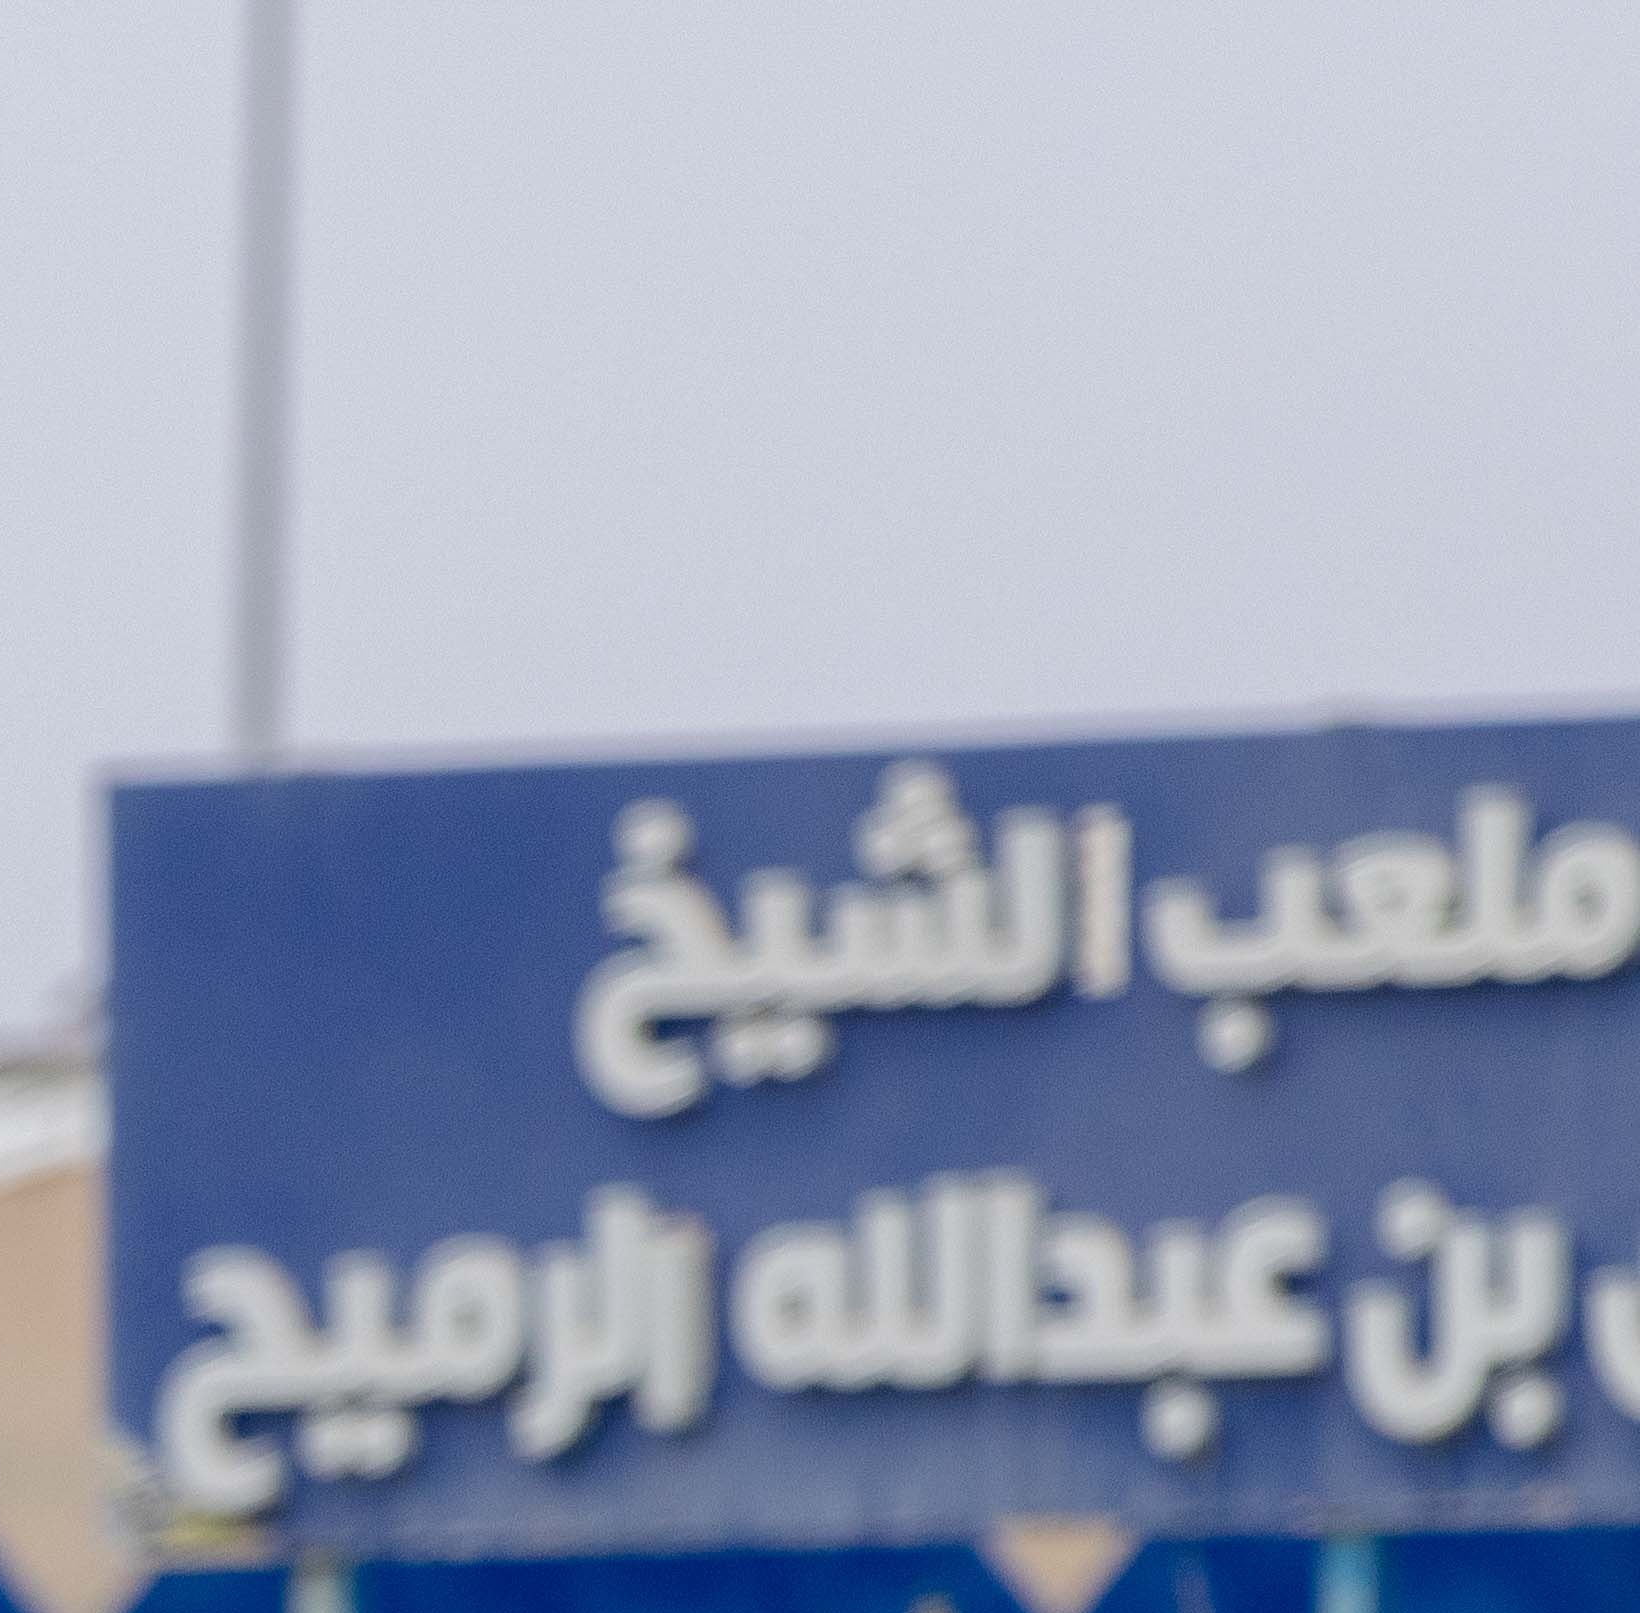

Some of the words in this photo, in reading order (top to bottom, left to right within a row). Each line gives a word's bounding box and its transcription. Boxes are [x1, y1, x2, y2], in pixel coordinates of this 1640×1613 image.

[580, 766, 1132, 1117] الشيخ
[1146, 786, 1640, 1072] ملعب
[158, 1185, 716, 1516] الرميح
[734, 1170, 1332, 1460] عبدالله
[1348, 1180, 1572, 1450] بن
